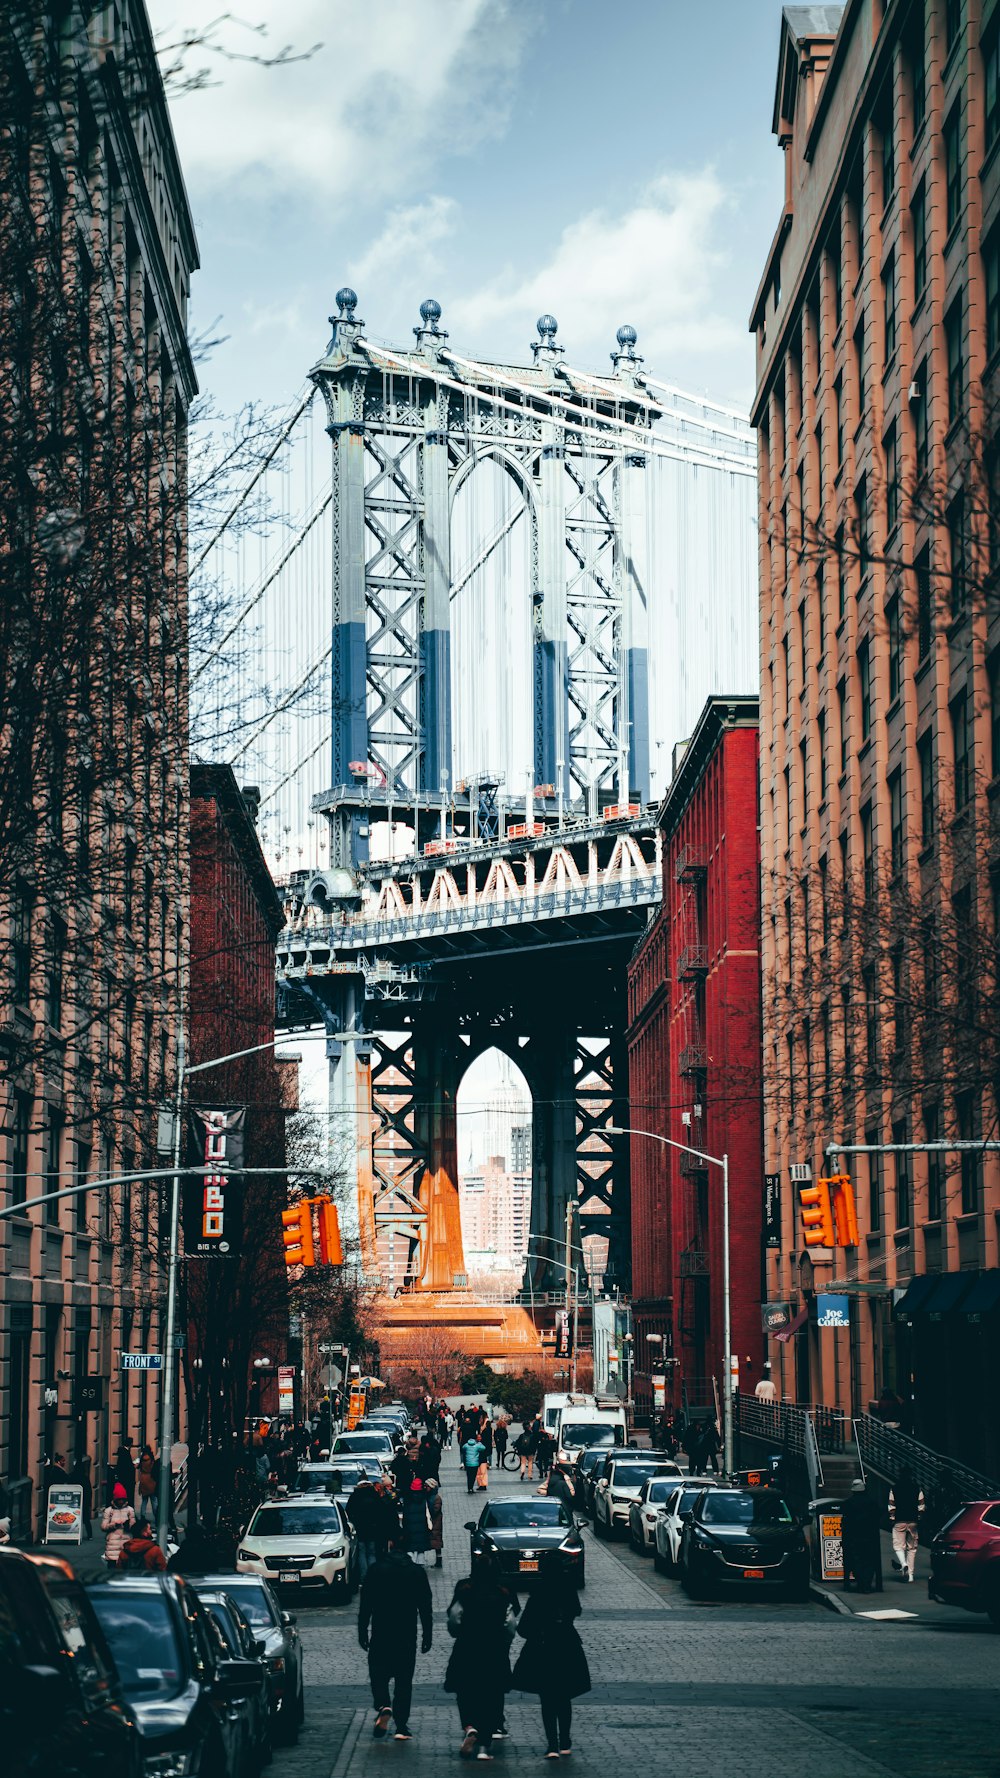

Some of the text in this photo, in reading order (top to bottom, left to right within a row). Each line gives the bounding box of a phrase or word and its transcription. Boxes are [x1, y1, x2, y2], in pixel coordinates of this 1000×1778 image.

[203, 1110, 229, 1237] DUMBO
[765, 1185, 773, 1217] Washington
[197, 1243, 210, 1251] BIG
[768, 1312, 784, 1321] SALON
[824, 1309, 844, 1320] Joe
[768, 1316, 787, 1326] DUMBO
[817, 1317, 850, 1327] Coffee
[561, 1311, 570, 1353] DUMBO
[124, 1356, 152, 1368] FRONT
[773, 1461, 779, 1471] P
